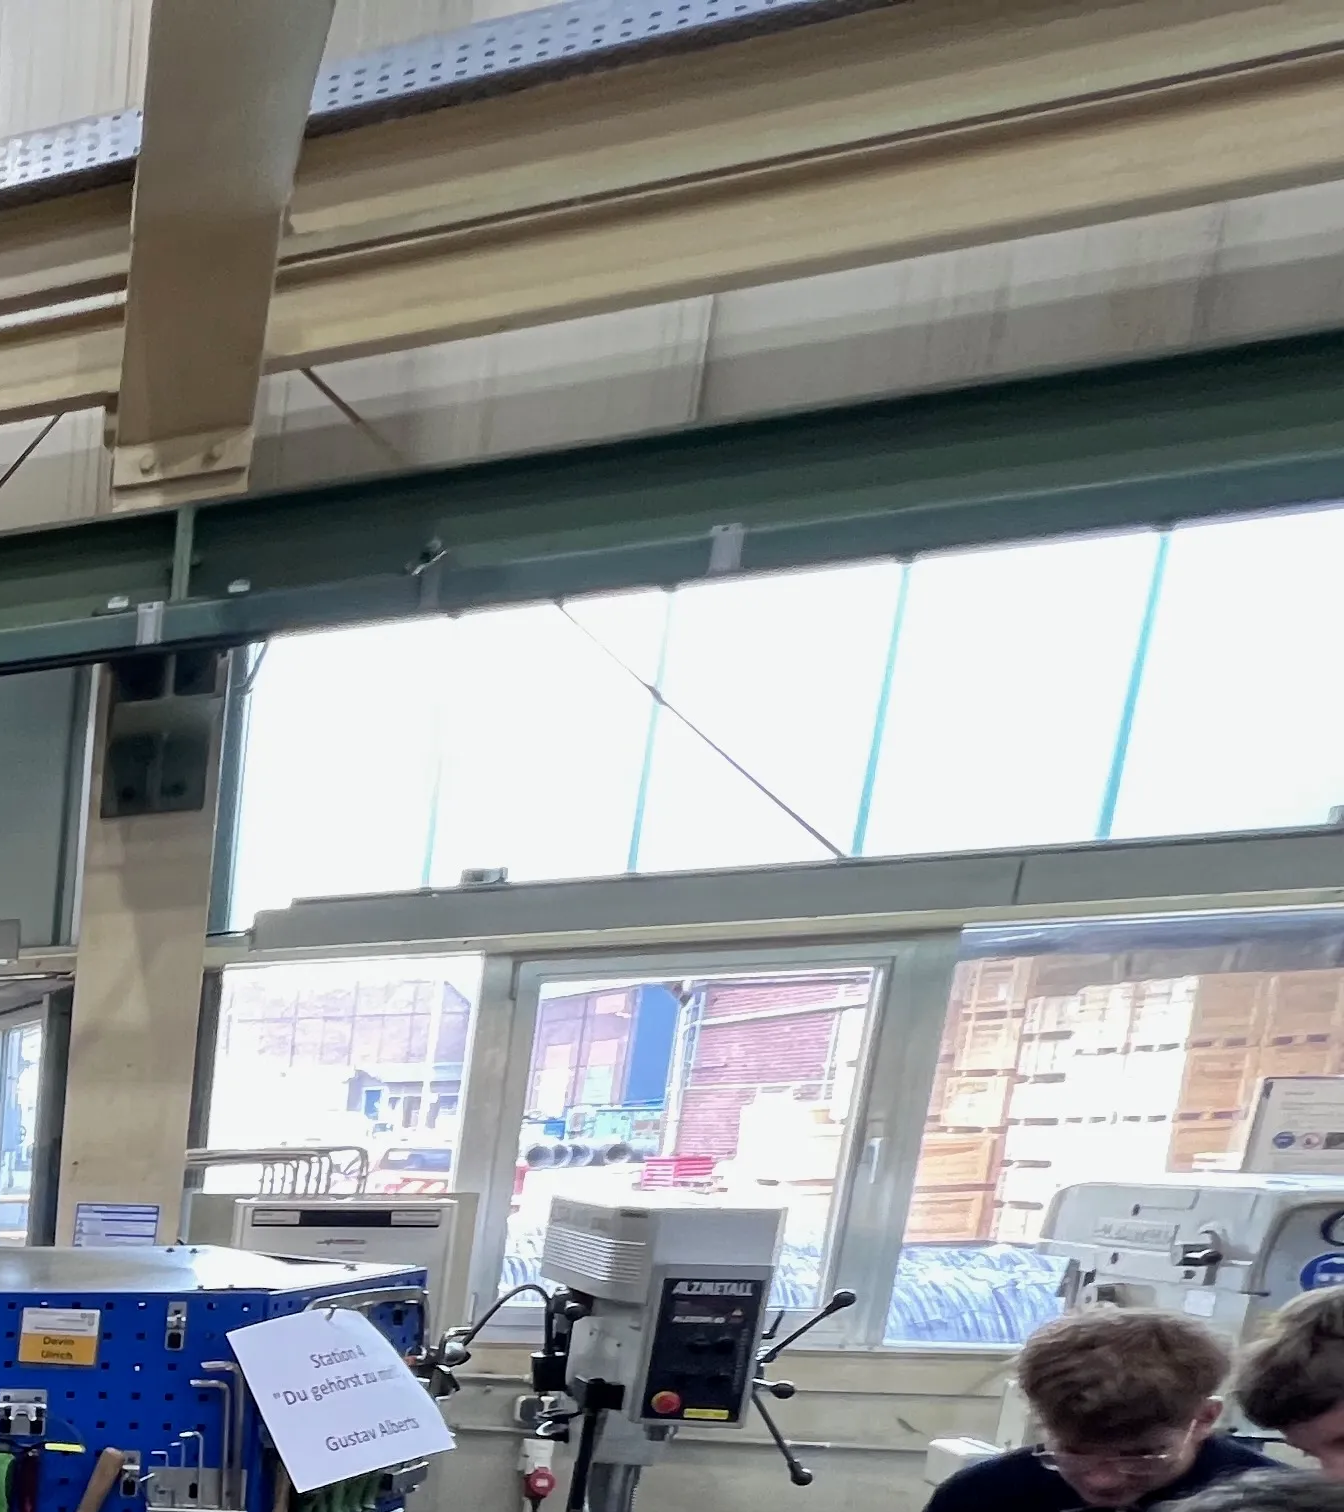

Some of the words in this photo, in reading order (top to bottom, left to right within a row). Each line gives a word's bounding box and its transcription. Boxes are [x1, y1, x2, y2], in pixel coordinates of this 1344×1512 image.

[672, 1281, 753, 1297] ALZMETALL
[310, 1347, 355, 1369] Station
[273, 1389, 308, 1406] "Du
[311, 1374, 363, 1402] gehörst
[364, 1371, 378, 1385] zu
[325, 1428, 376, 1452] Gustav
[379, 1416, 420, 1437] Alberts
